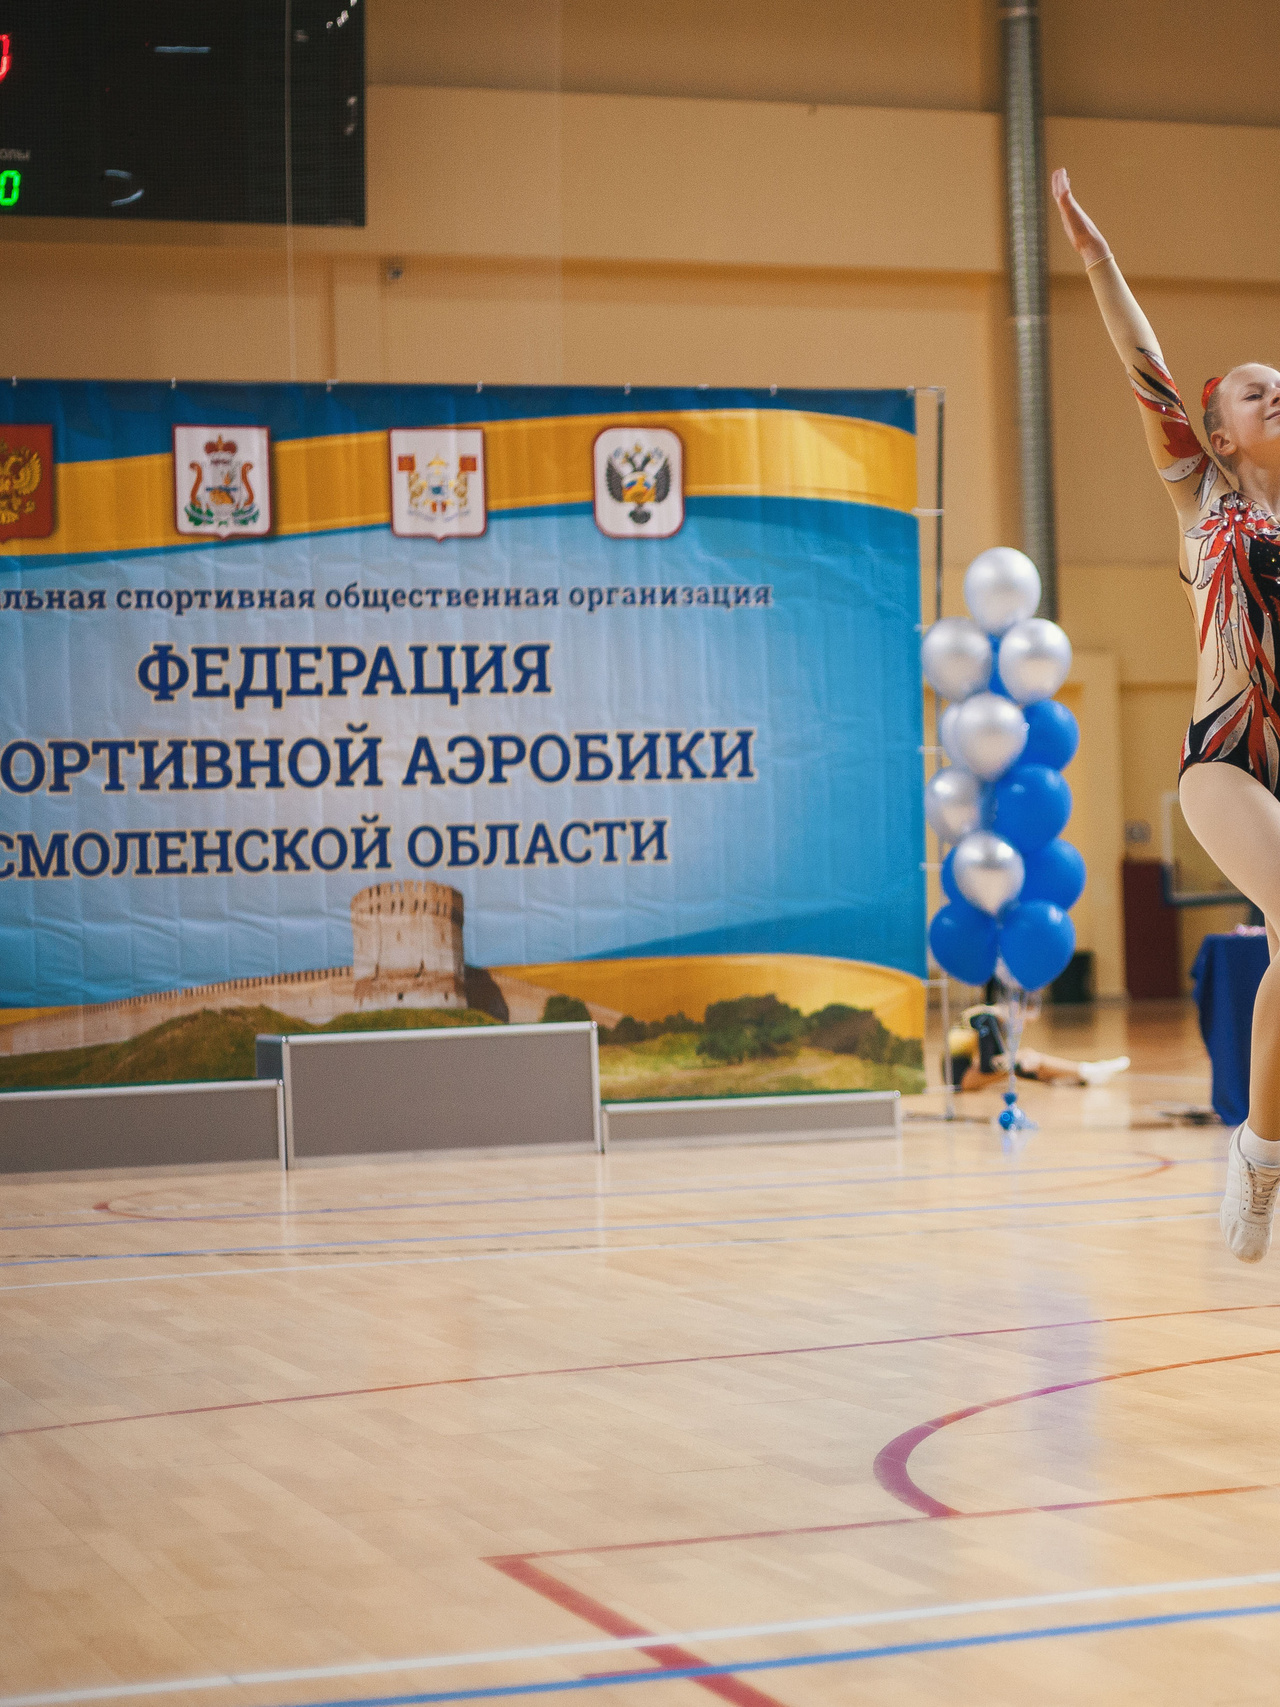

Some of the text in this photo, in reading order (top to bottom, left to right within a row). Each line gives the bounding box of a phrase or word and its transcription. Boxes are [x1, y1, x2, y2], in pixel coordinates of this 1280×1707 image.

[2, 582, 773, 615] льная спортивная общественная организация
[137, 643, 552, 709] ФЕДЕРАЦИЯ
[0, 722, 755, 794] ОРТИВНОЙ АЭРОБИКИ
[407, 820, 668, 868] ОБЛАСТИ
